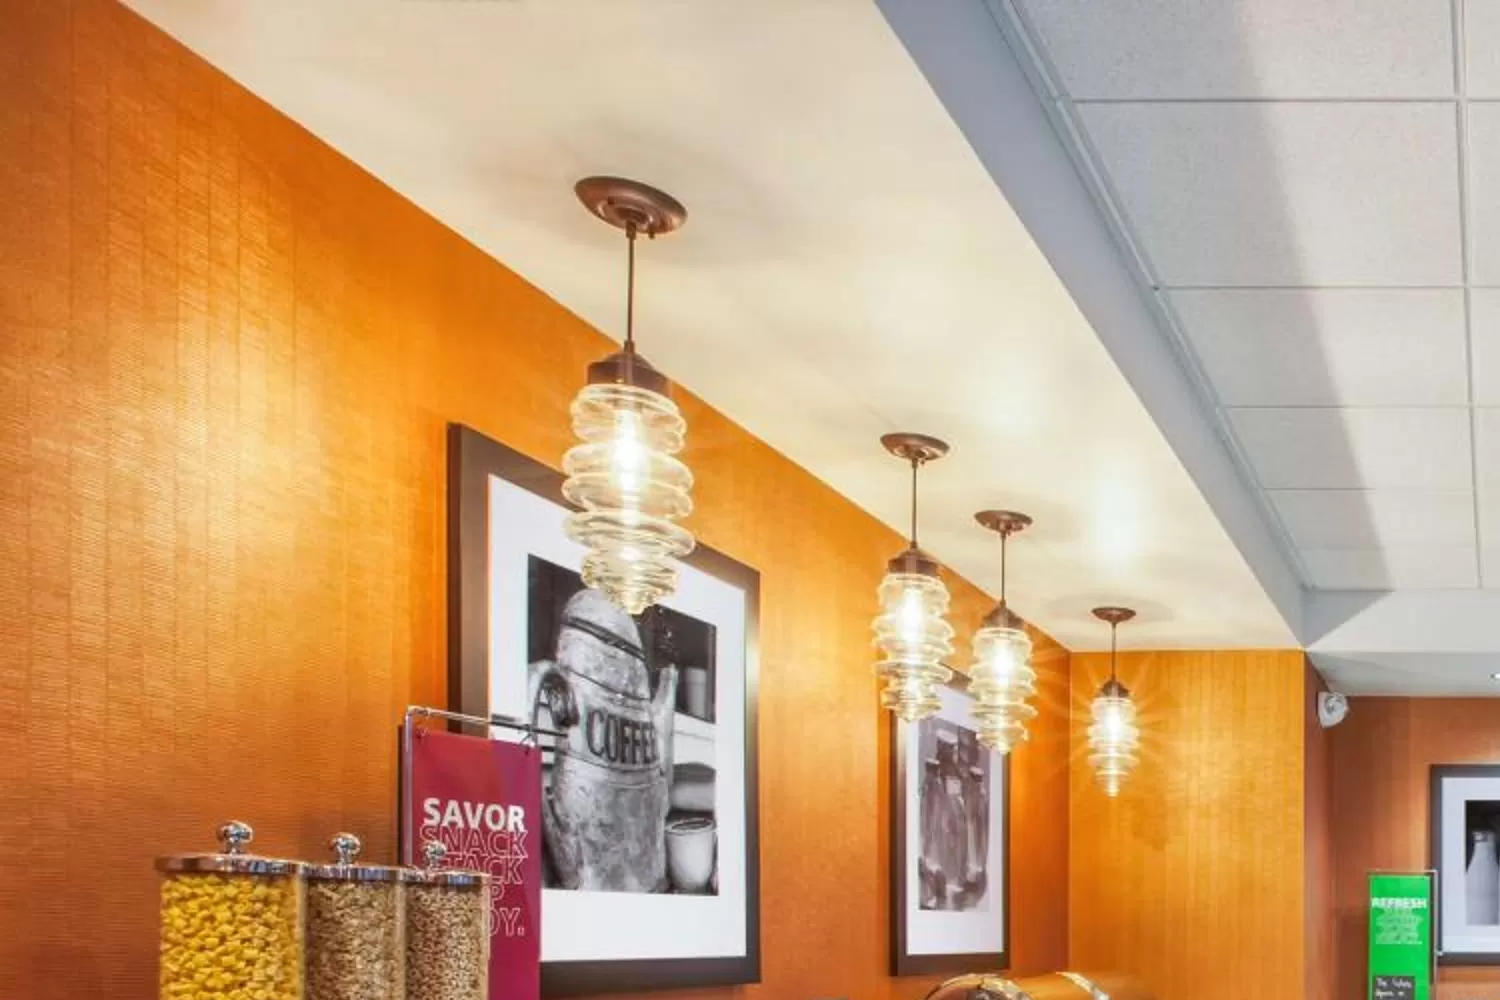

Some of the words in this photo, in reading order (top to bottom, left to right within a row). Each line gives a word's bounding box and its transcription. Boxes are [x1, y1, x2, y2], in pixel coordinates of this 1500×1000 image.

[586, 706, 660, 764] COFFEE
[423, 797, 526, 832] SAVOR
[419, 823, 529, 858] SNACK
[1371, 897, 1427, 909] REFRESH
